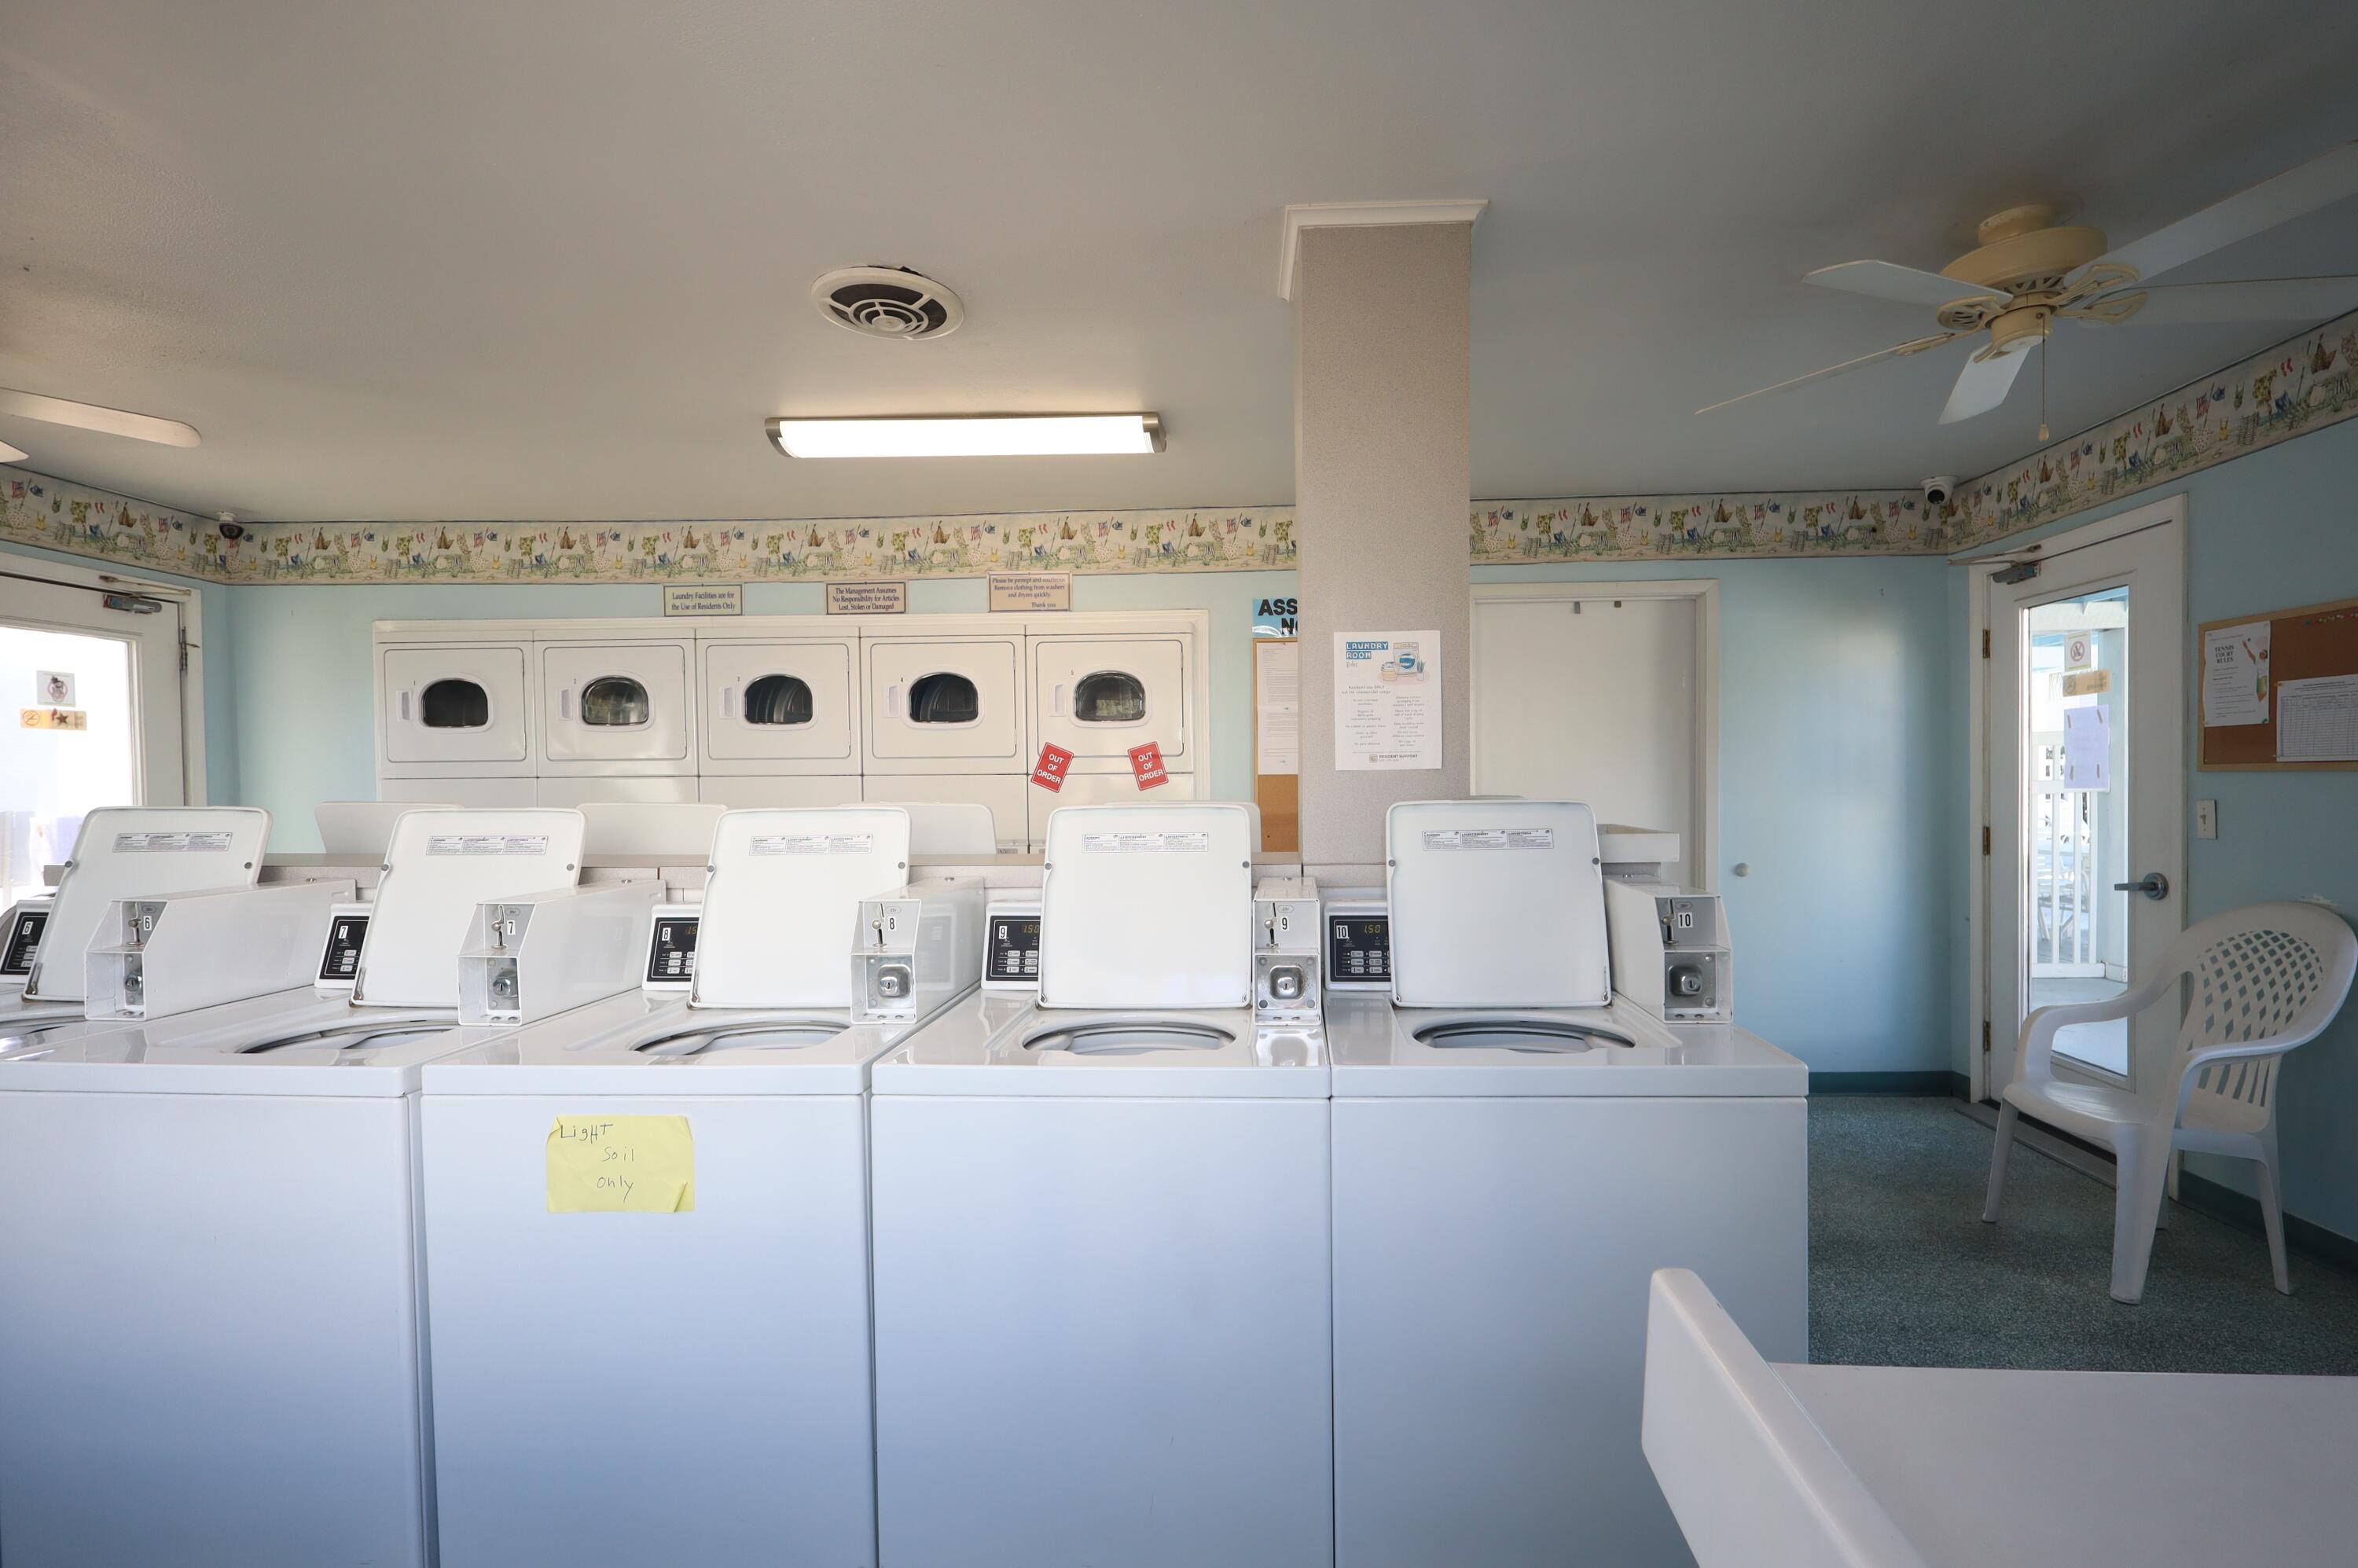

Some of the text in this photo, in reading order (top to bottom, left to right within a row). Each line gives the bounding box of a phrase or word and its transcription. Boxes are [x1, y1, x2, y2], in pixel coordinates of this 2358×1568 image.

[673, 592, 693, 601] Laundry
[845, 587, 875, 596] Management
[841, 595, 872, 604] Responsibility
[723, 601, 736, 611] Only
[1258, 598, 1298, 616] ASS
[1281, 618, 1298, 635] N
[1049, 754, 1064, 764] OUT
[1138, 752, 1152, 762] OUT
[1047, 763, 1058, 772] OF
[1143, 762, 1153, 770] OF
[1037, 769, 1061, 784] ORDER
[1139, 769, 1164, 781] ORDER
[145, 917, 150, 930] 6
[889, 917, 895, 930] 8
[1281, 917, 1288, 930] 9
[1679, 914, 1691, 927] 10
[24, 923, 31, 934] 6
[340, 927, 347, 938] 7
[508, 921, 513, 934] 7
[1000, 927, 1006, 938] 9
[1337, 927, 1346, 938] 10
[663, 928, 669, 940] 8
